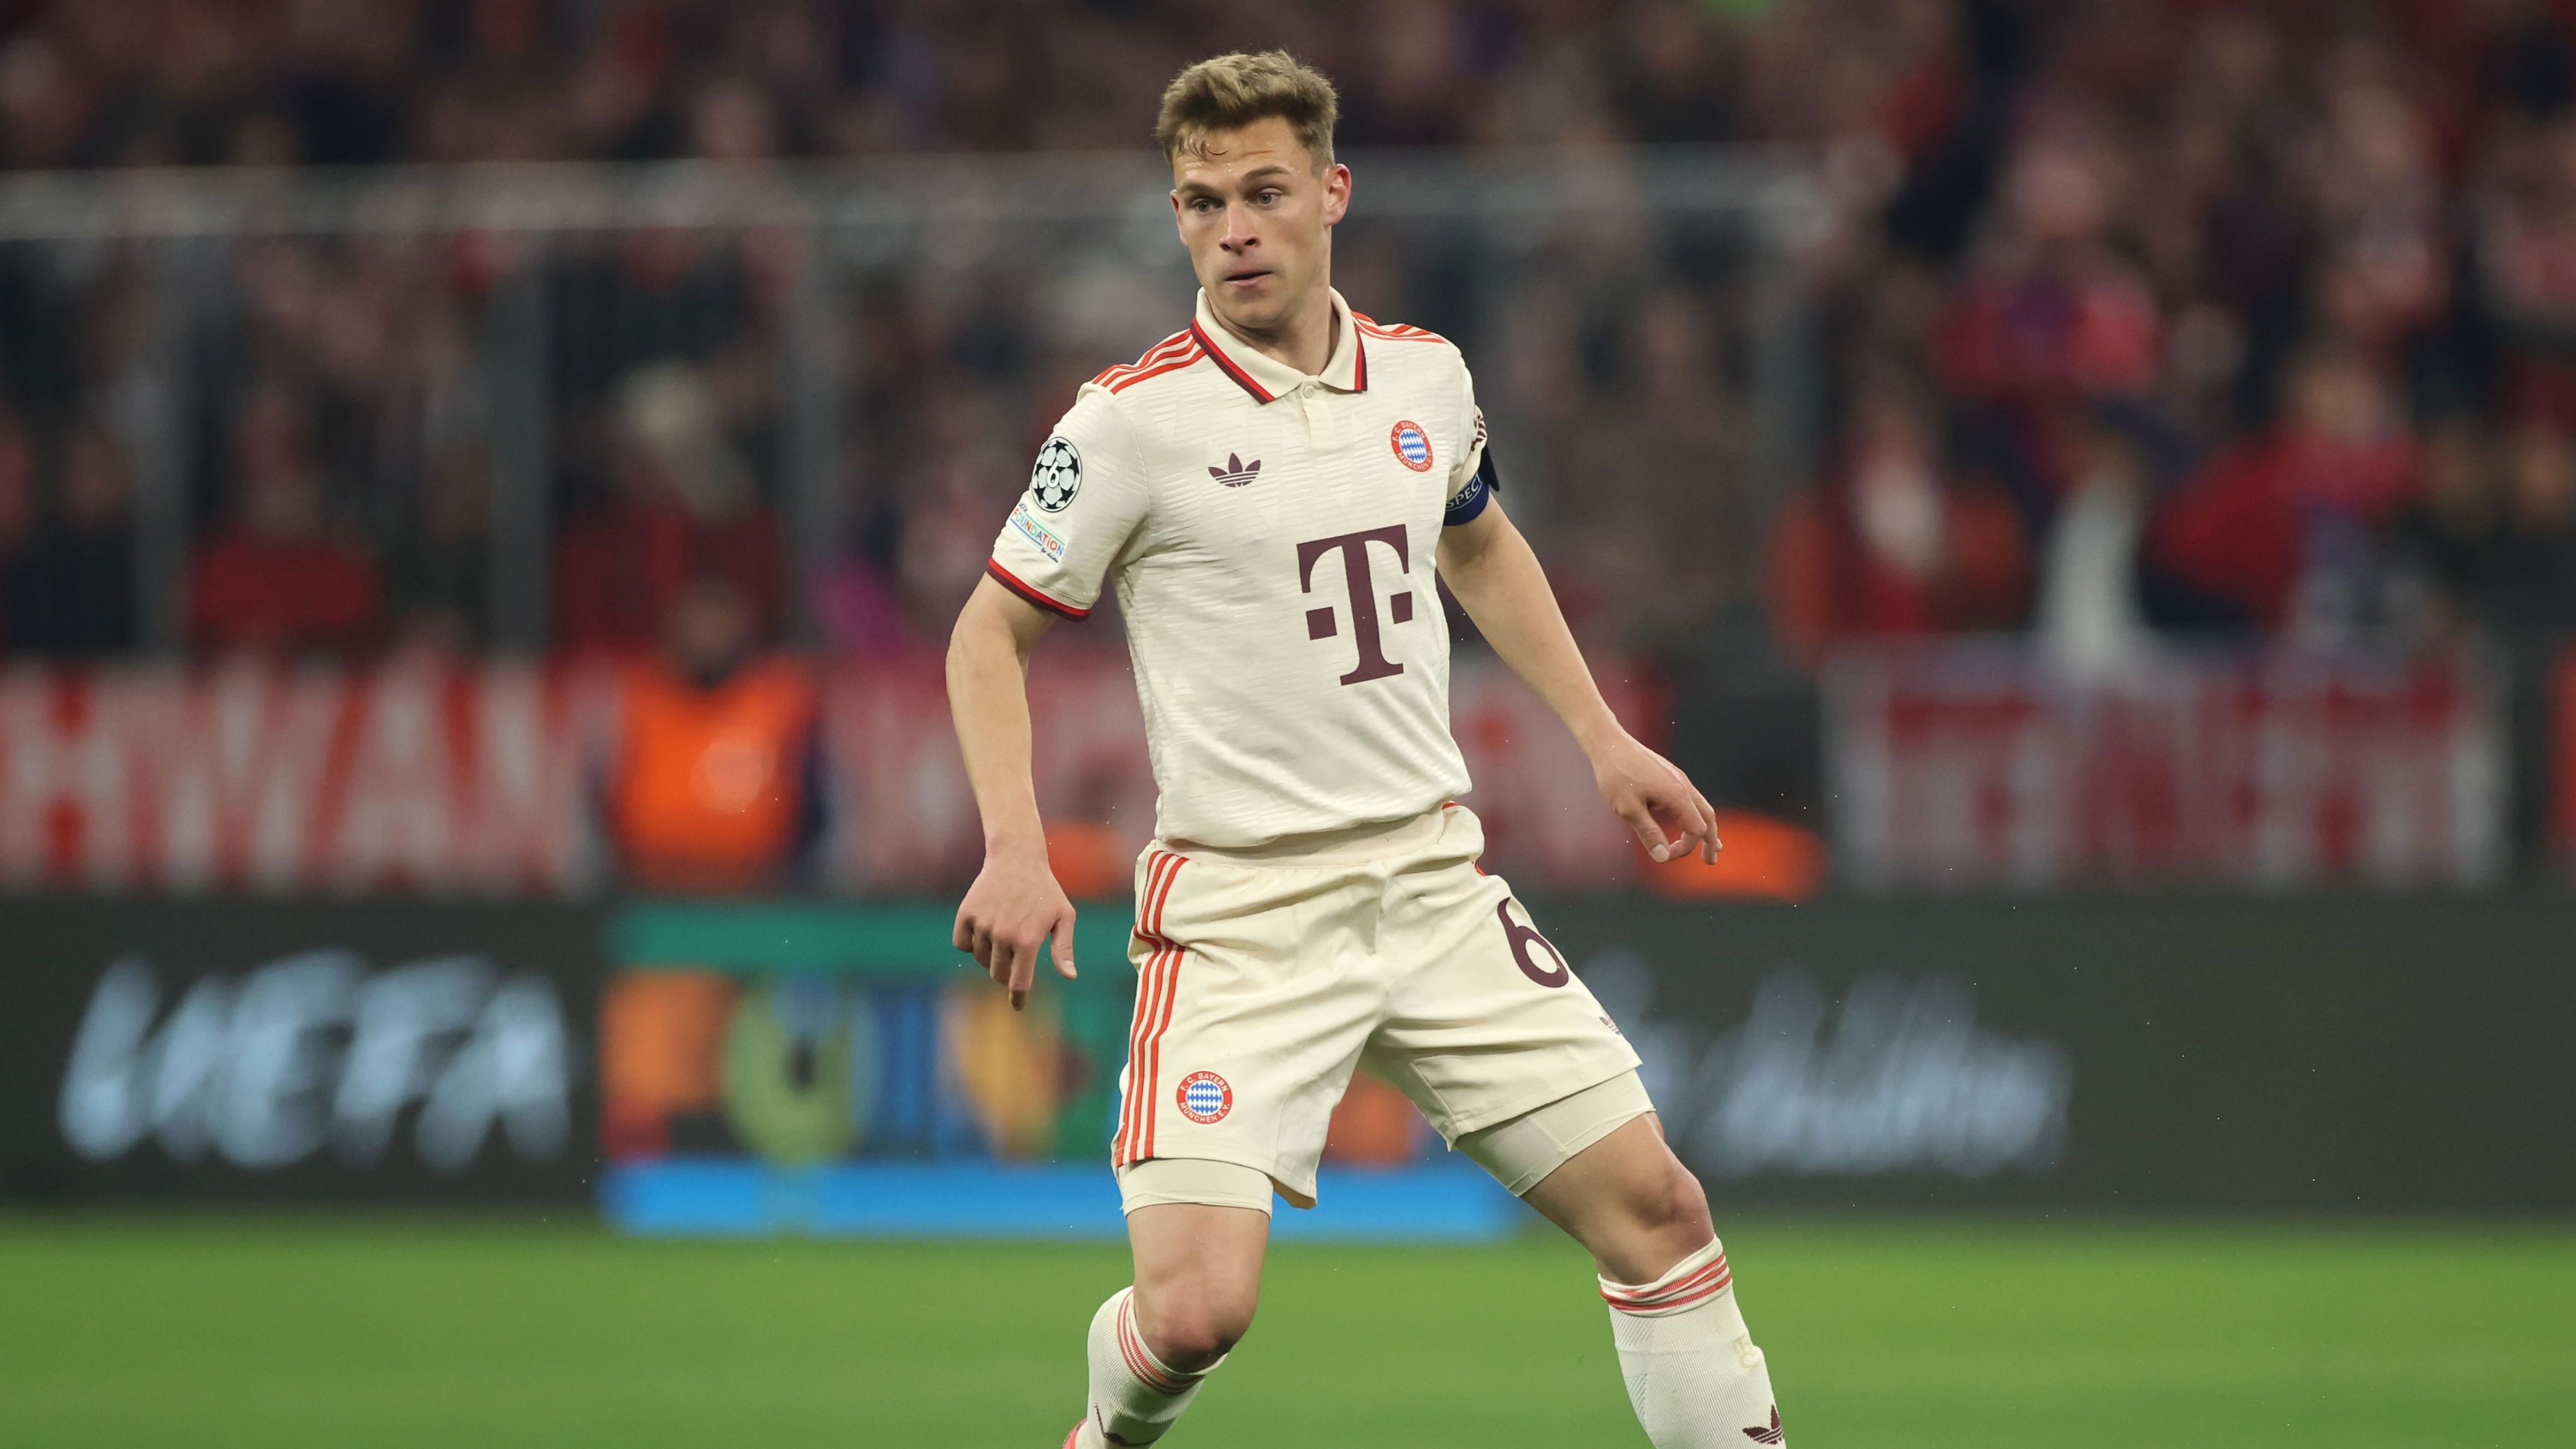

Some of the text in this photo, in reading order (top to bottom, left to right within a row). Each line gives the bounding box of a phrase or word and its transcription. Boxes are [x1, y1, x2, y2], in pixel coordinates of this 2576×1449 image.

[1400, 422, 1425, 438] BAYERN
[1047, 460, 1060, 488] 6
[1012, 508, 1064, 556] FOUNDATION
[1497, 897, 1569, 988] 6
[1197, 1073, 1229, 1092] BAYERN
